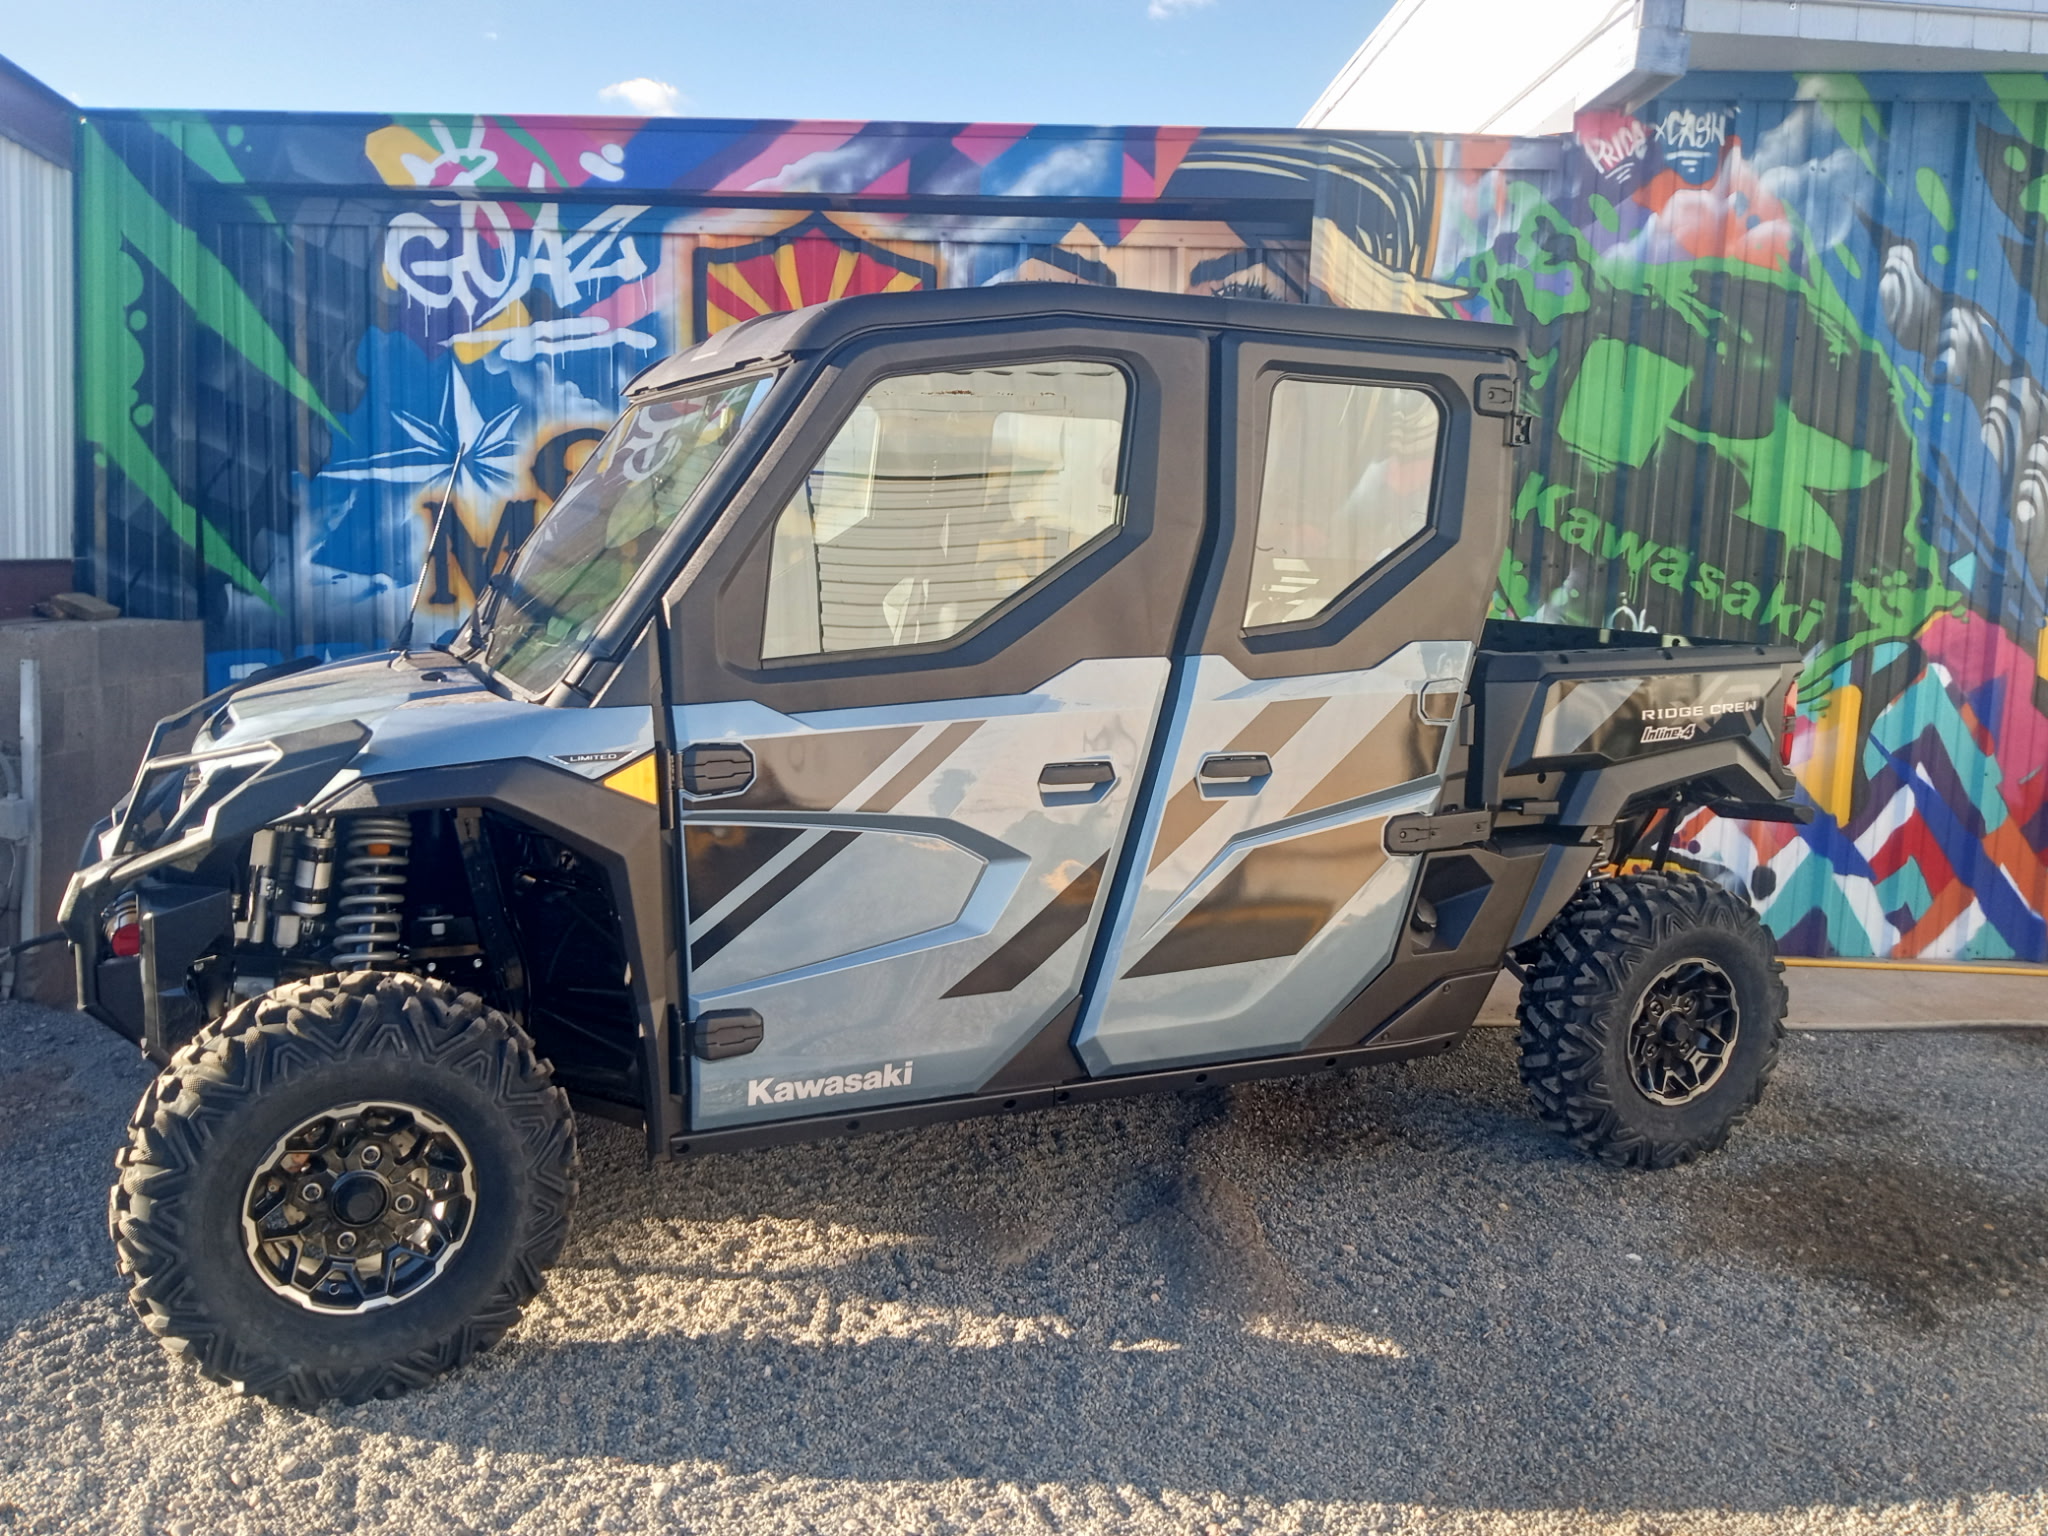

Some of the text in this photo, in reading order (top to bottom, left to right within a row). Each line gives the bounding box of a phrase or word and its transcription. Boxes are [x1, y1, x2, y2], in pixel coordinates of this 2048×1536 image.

[1511, 471, 1825, 643] Kawasaki
[1641, 700, 1757, 721] RIDGE CREW
[569, 753, 617, 762] LIMITED
[747, 1060, 914, 1107] Kawasaki
